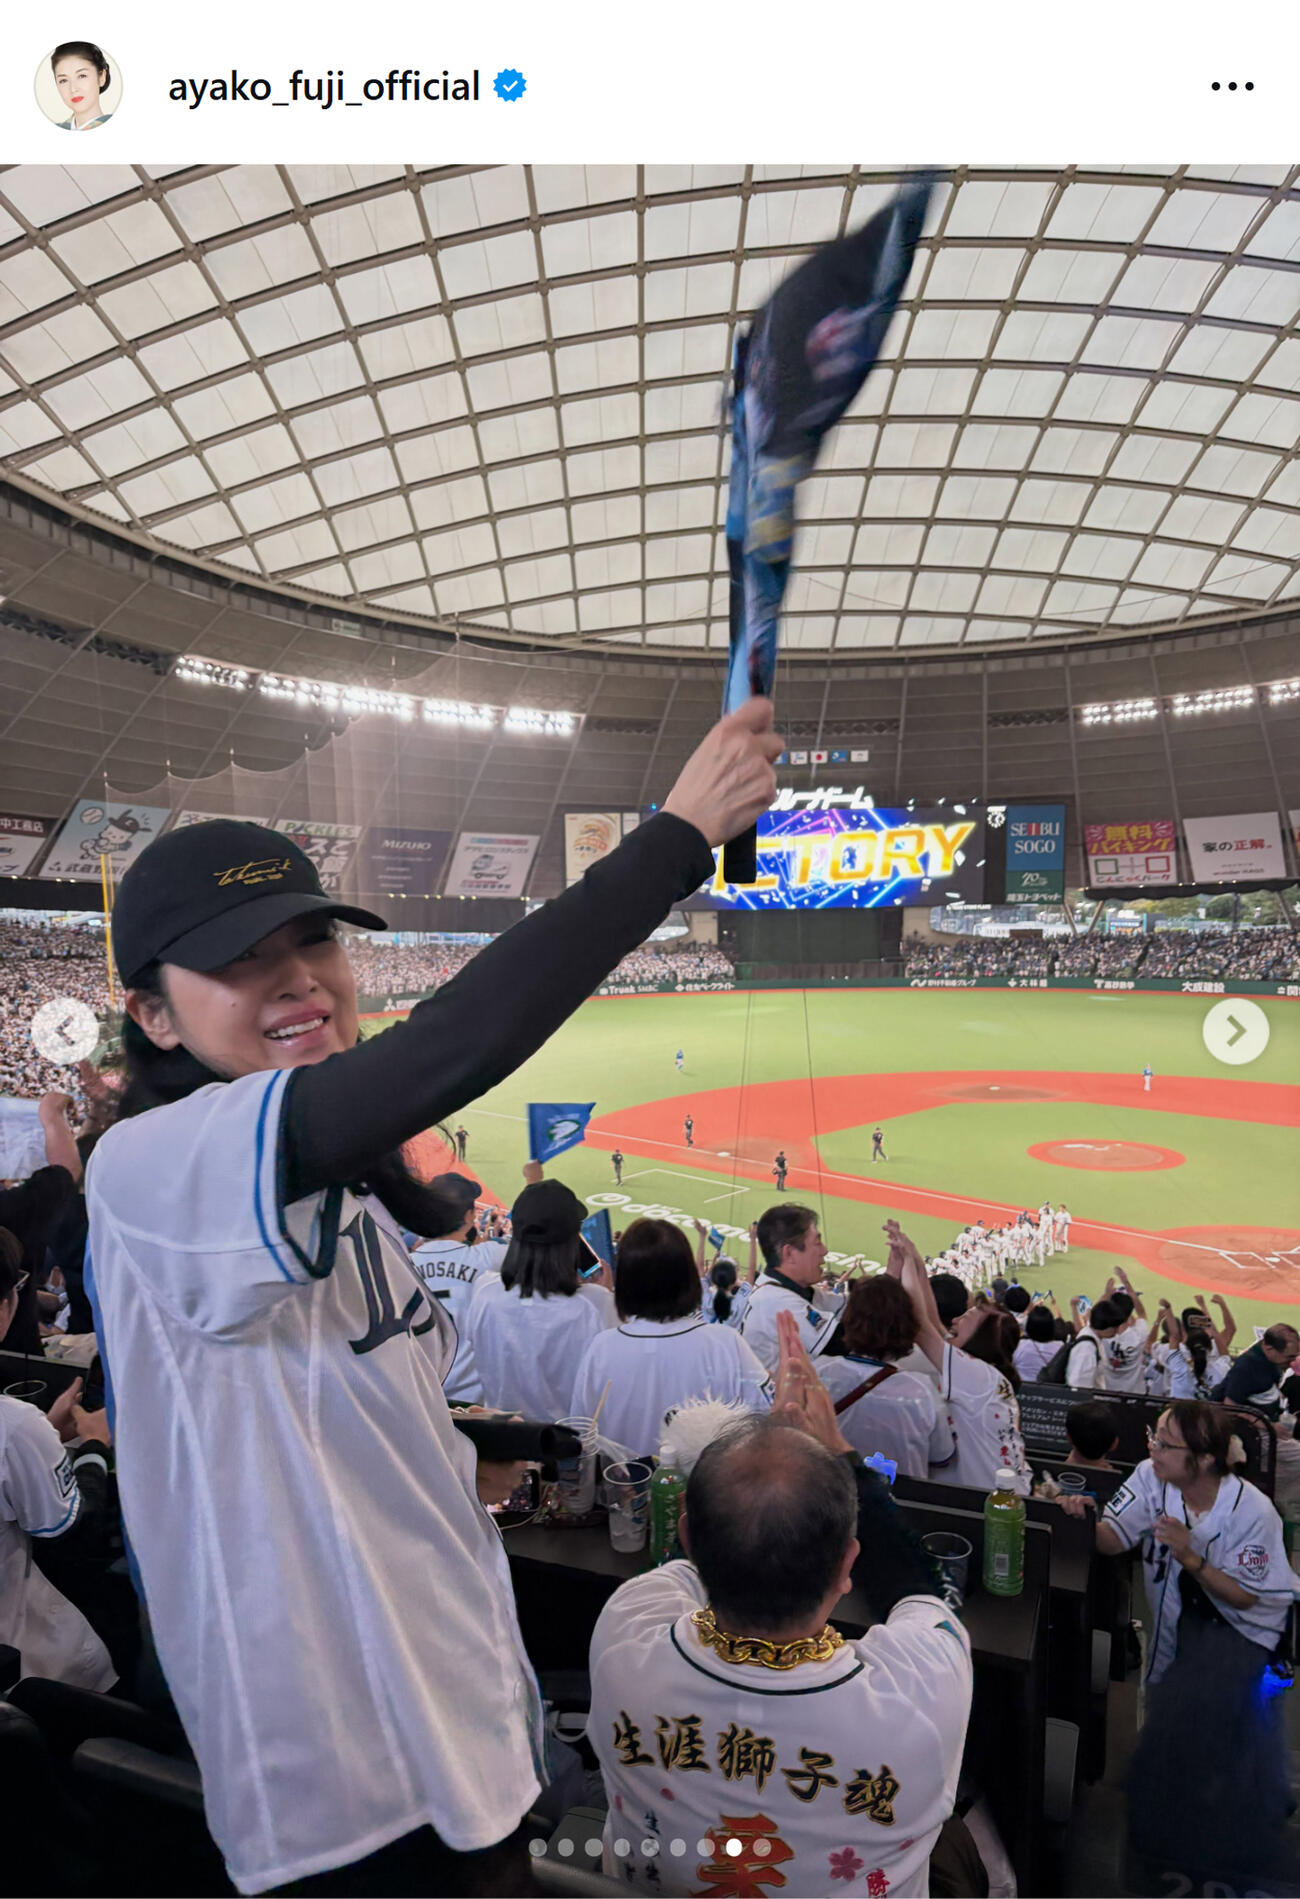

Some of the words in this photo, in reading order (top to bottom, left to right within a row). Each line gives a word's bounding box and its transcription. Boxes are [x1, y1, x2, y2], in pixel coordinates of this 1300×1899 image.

[769, 786, 873, 810] ルーナドーム
[1010, 822, 1060, 837] SEIBU
[382, 839, 432, 851] MIZUHO
[1014, 840, 1056, 854] SOGO
[1091, 838, 1172, 854] バイキング
[1006, 892, 1063, 903] 埼玉トヨペット
[1181, 981, 1225, 993] 大成建設
[414, 1261, 478, 1284] NOSAKI
[611, 1709, 900, 1826] 生涯獅子魂
